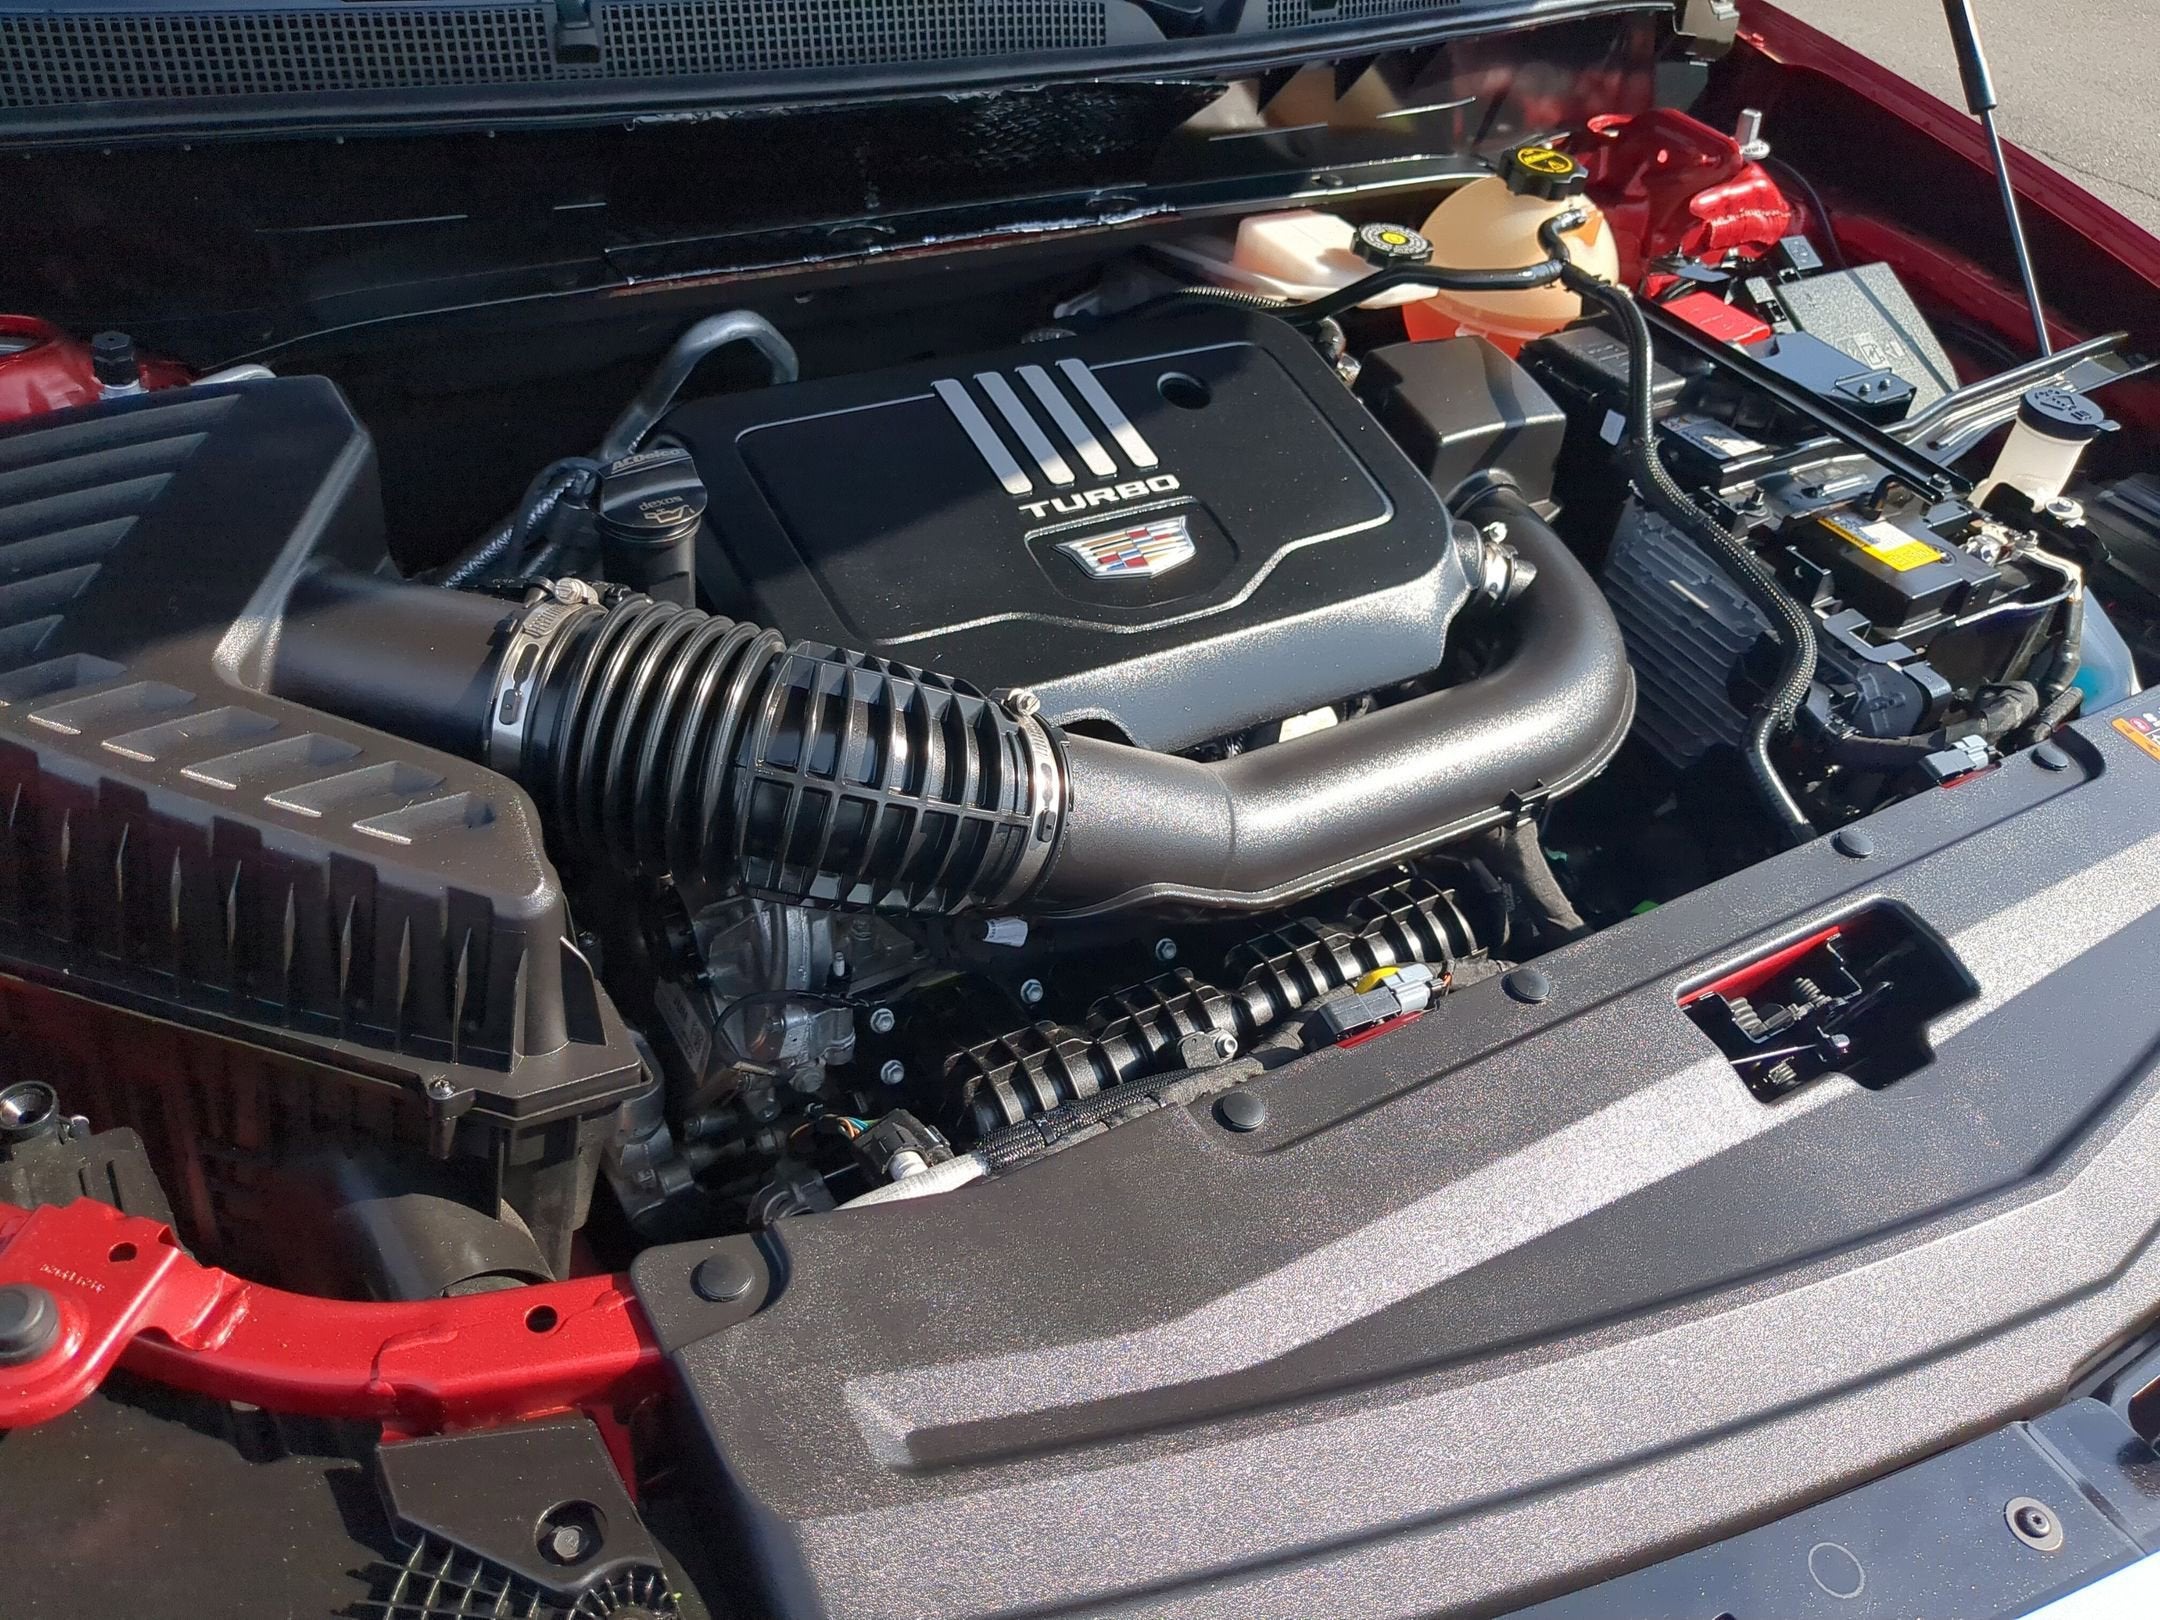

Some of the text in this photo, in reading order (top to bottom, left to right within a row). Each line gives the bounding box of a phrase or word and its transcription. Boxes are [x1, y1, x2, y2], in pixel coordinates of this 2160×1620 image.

[611, 449, 681, 473] ACDelco
[639, 495, 684, 511] dexos
[1018, 474, 1180, 518] TURBO
